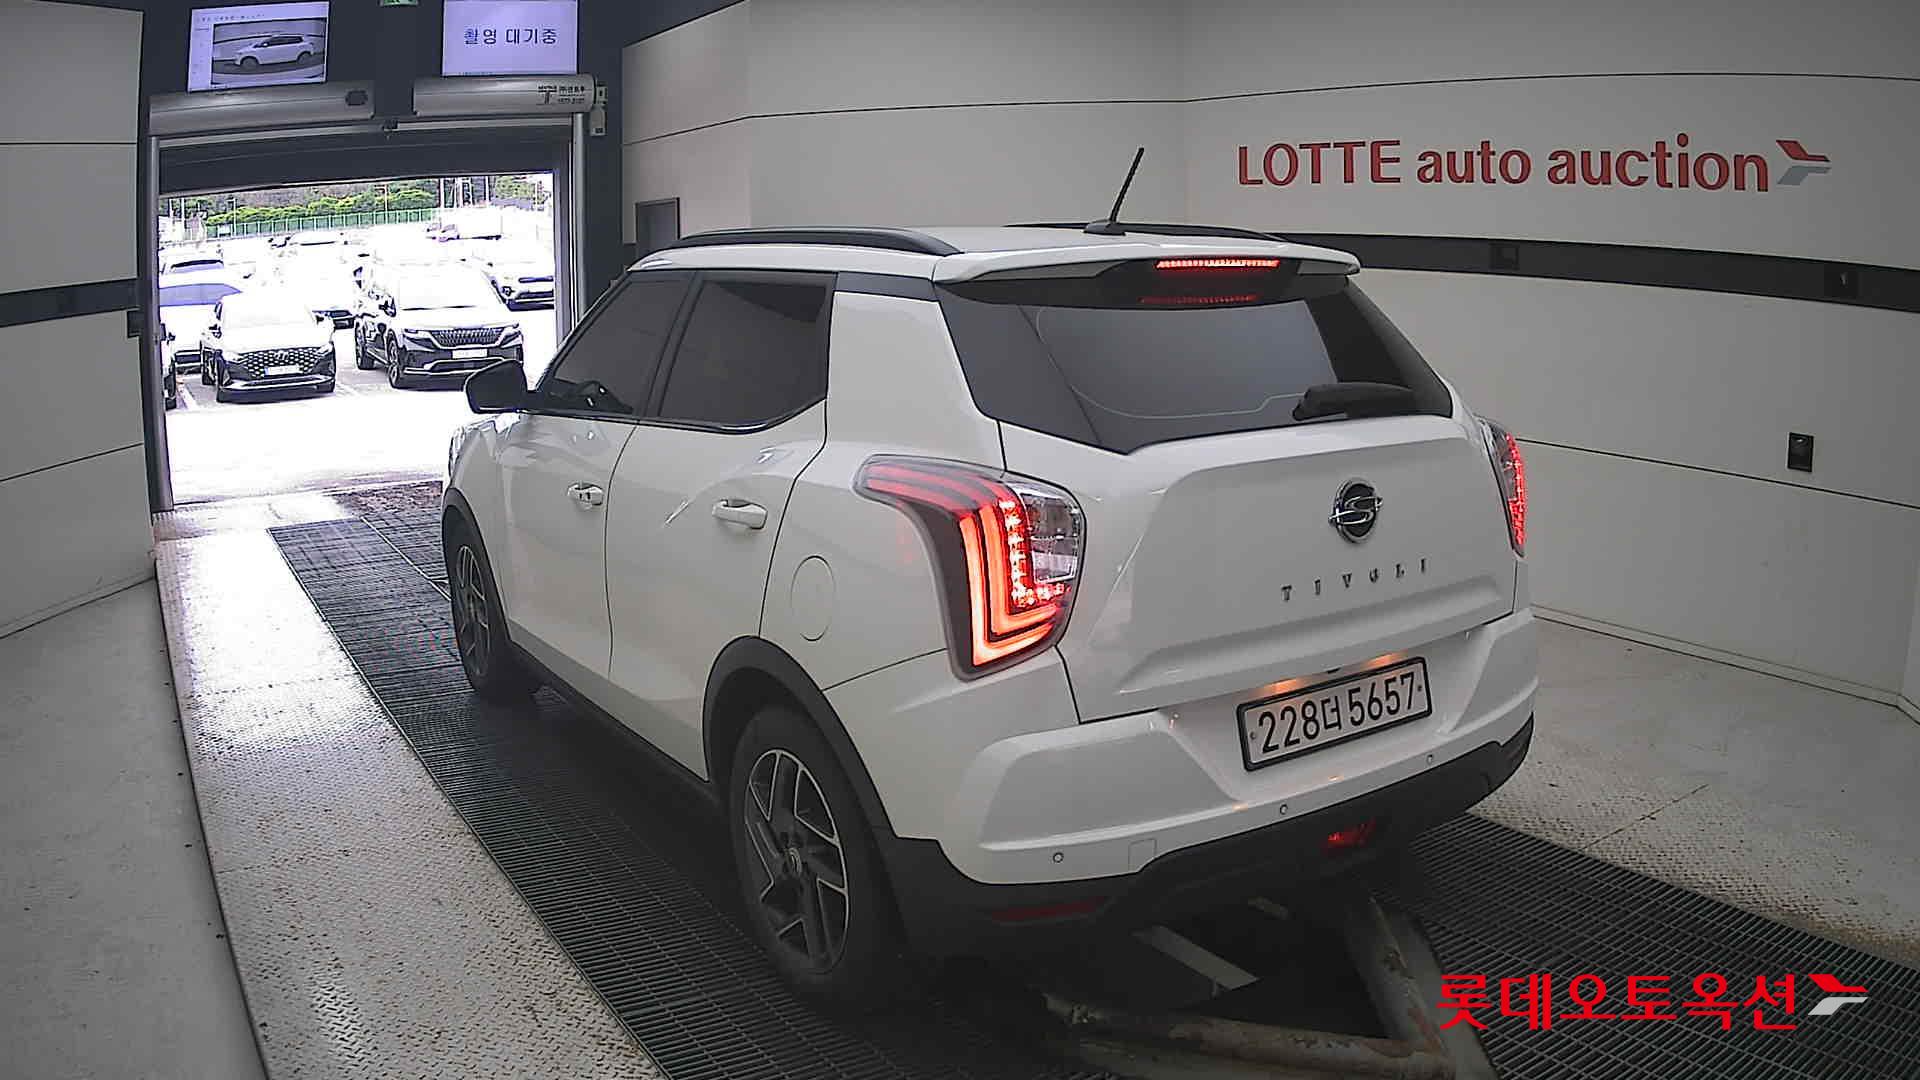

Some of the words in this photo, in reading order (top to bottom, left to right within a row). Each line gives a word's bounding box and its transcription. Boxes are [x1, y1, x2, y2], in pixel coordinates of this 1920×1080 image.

[505, 28, 557, 45] 대기중
[1238, 139, 1402, 186] LOTTE
[1415, 139, 1532, 185] auto
[1546, 132, 1769, 192] auction
[1280, 557, 1427, 601] TIVOLI
[1347, 671, 1415, 727] 5657
